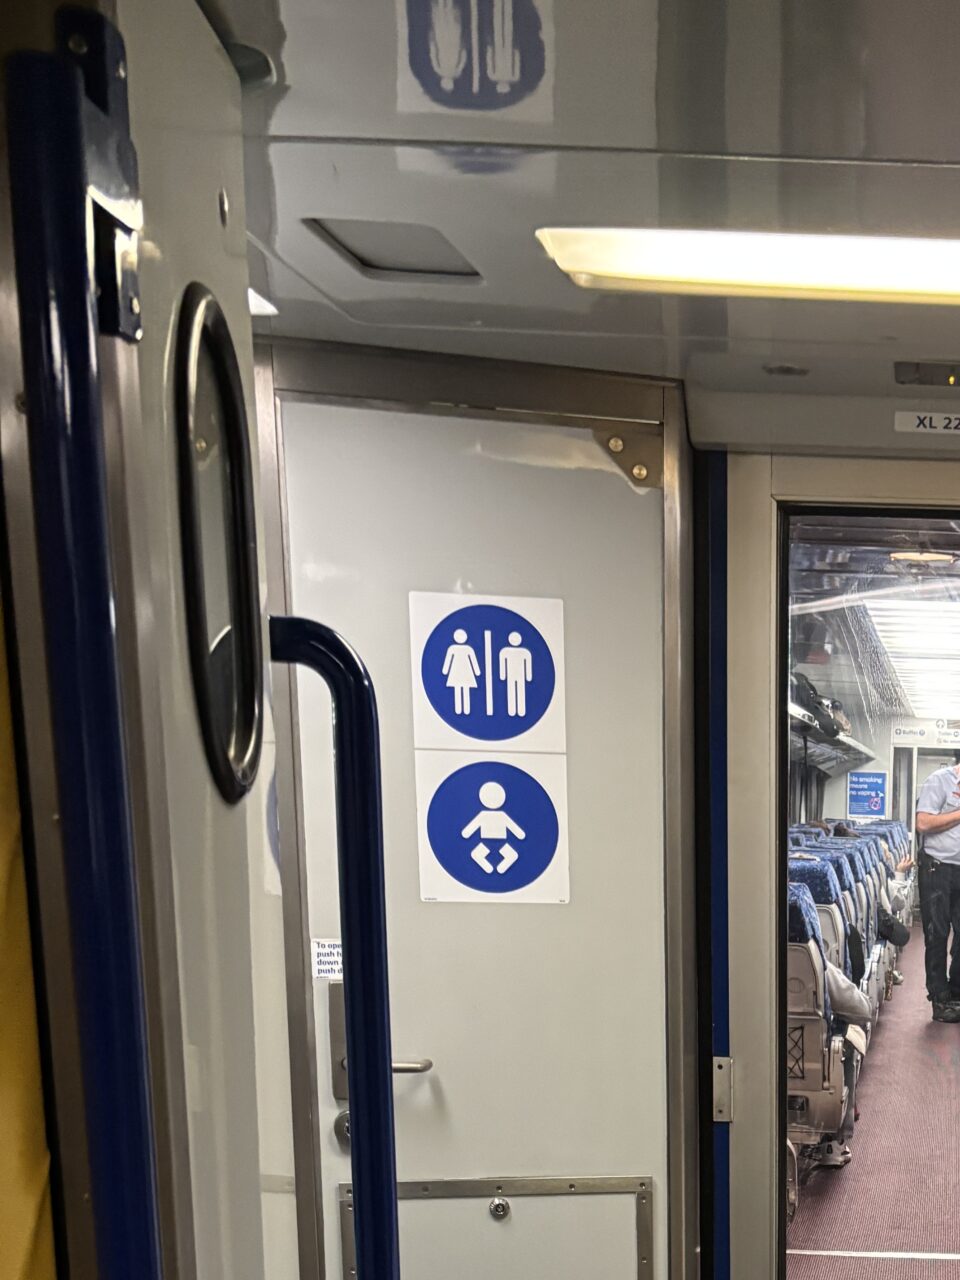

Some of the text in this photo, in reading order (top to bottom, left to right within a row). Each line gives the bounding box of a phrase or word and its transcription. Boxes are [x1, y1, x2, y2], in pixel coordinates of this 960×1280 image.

[916, 415, 937, 429] XL
[859, 776, 883, 784] smoking
[317, 941, 326, 949] To
[316, 950, 335, 959] push
[317, 967, 336, 975] push
